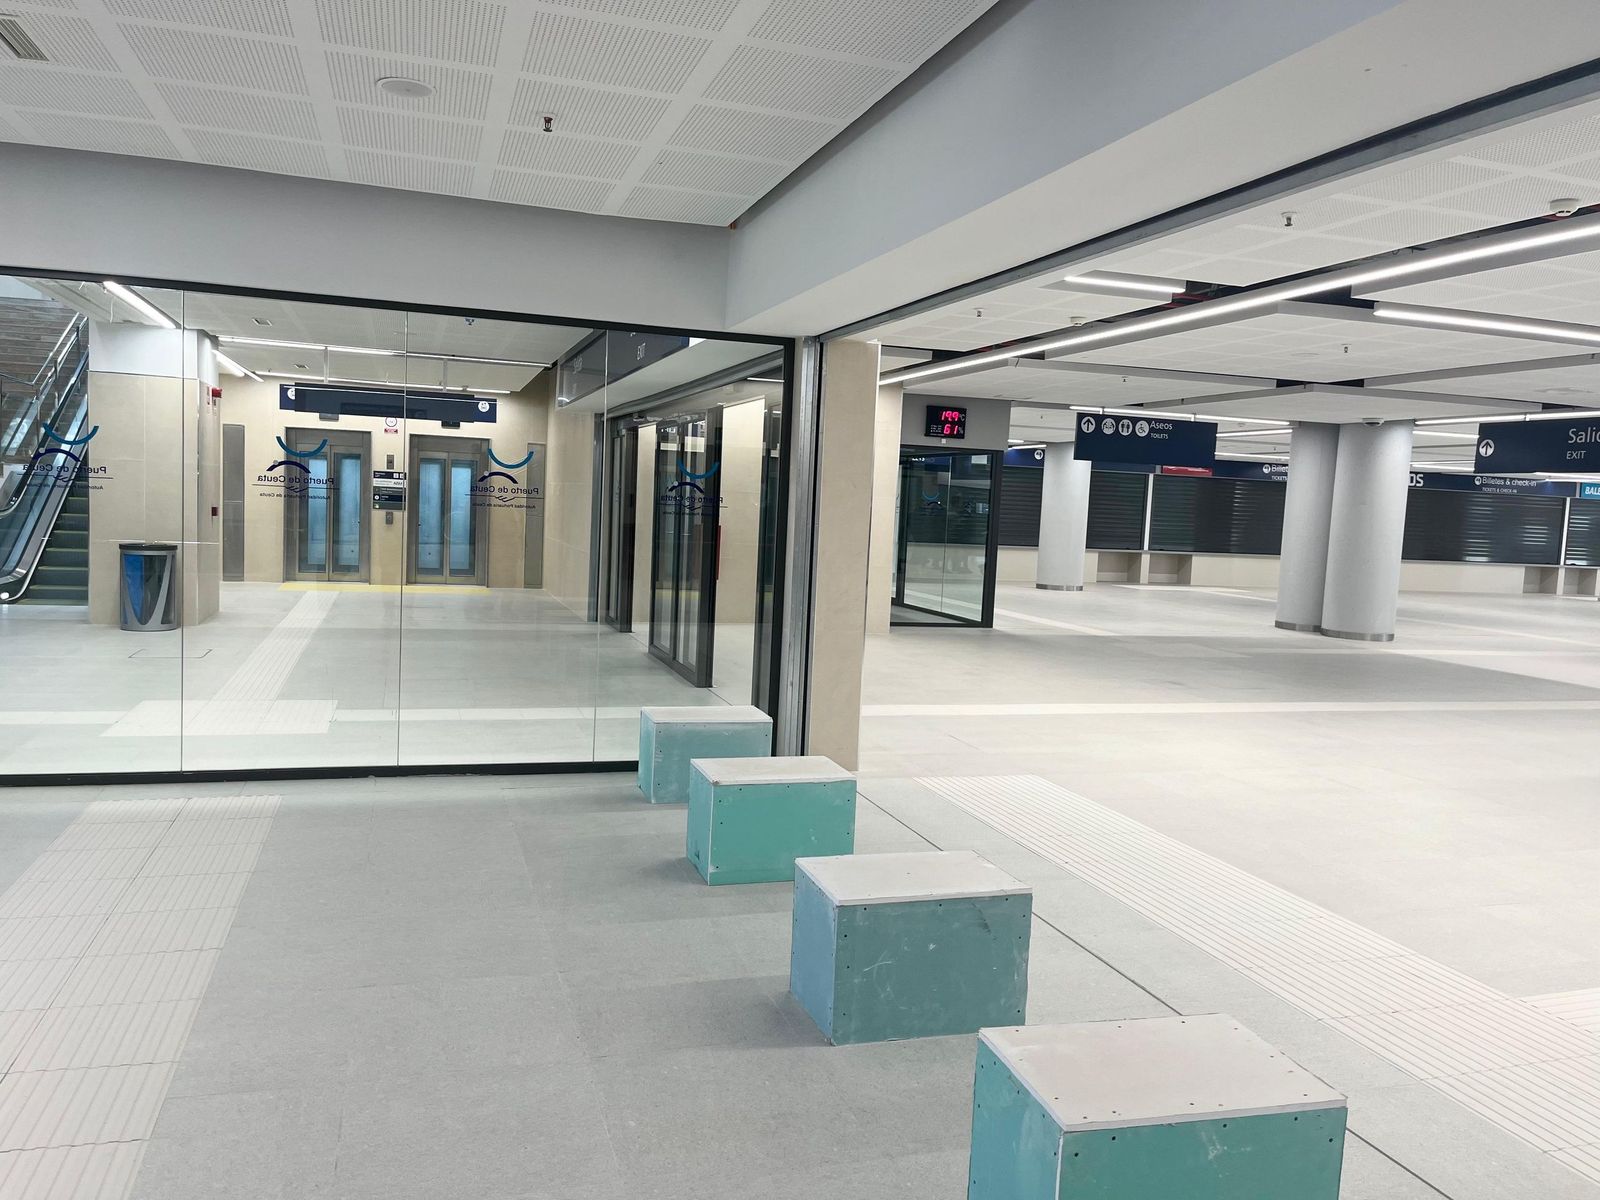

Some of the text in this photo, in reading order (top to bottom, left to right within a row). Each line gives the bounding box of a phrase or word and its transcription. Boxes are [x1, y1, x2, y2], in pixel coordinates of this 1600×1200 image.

[943, 423, 958, 435] 61
[1150, 420, 1173, 430] Aseos
[1566, 450, 1587, 460] EXIT
[1482, 476, 1537, 488] Billetes & check-in
